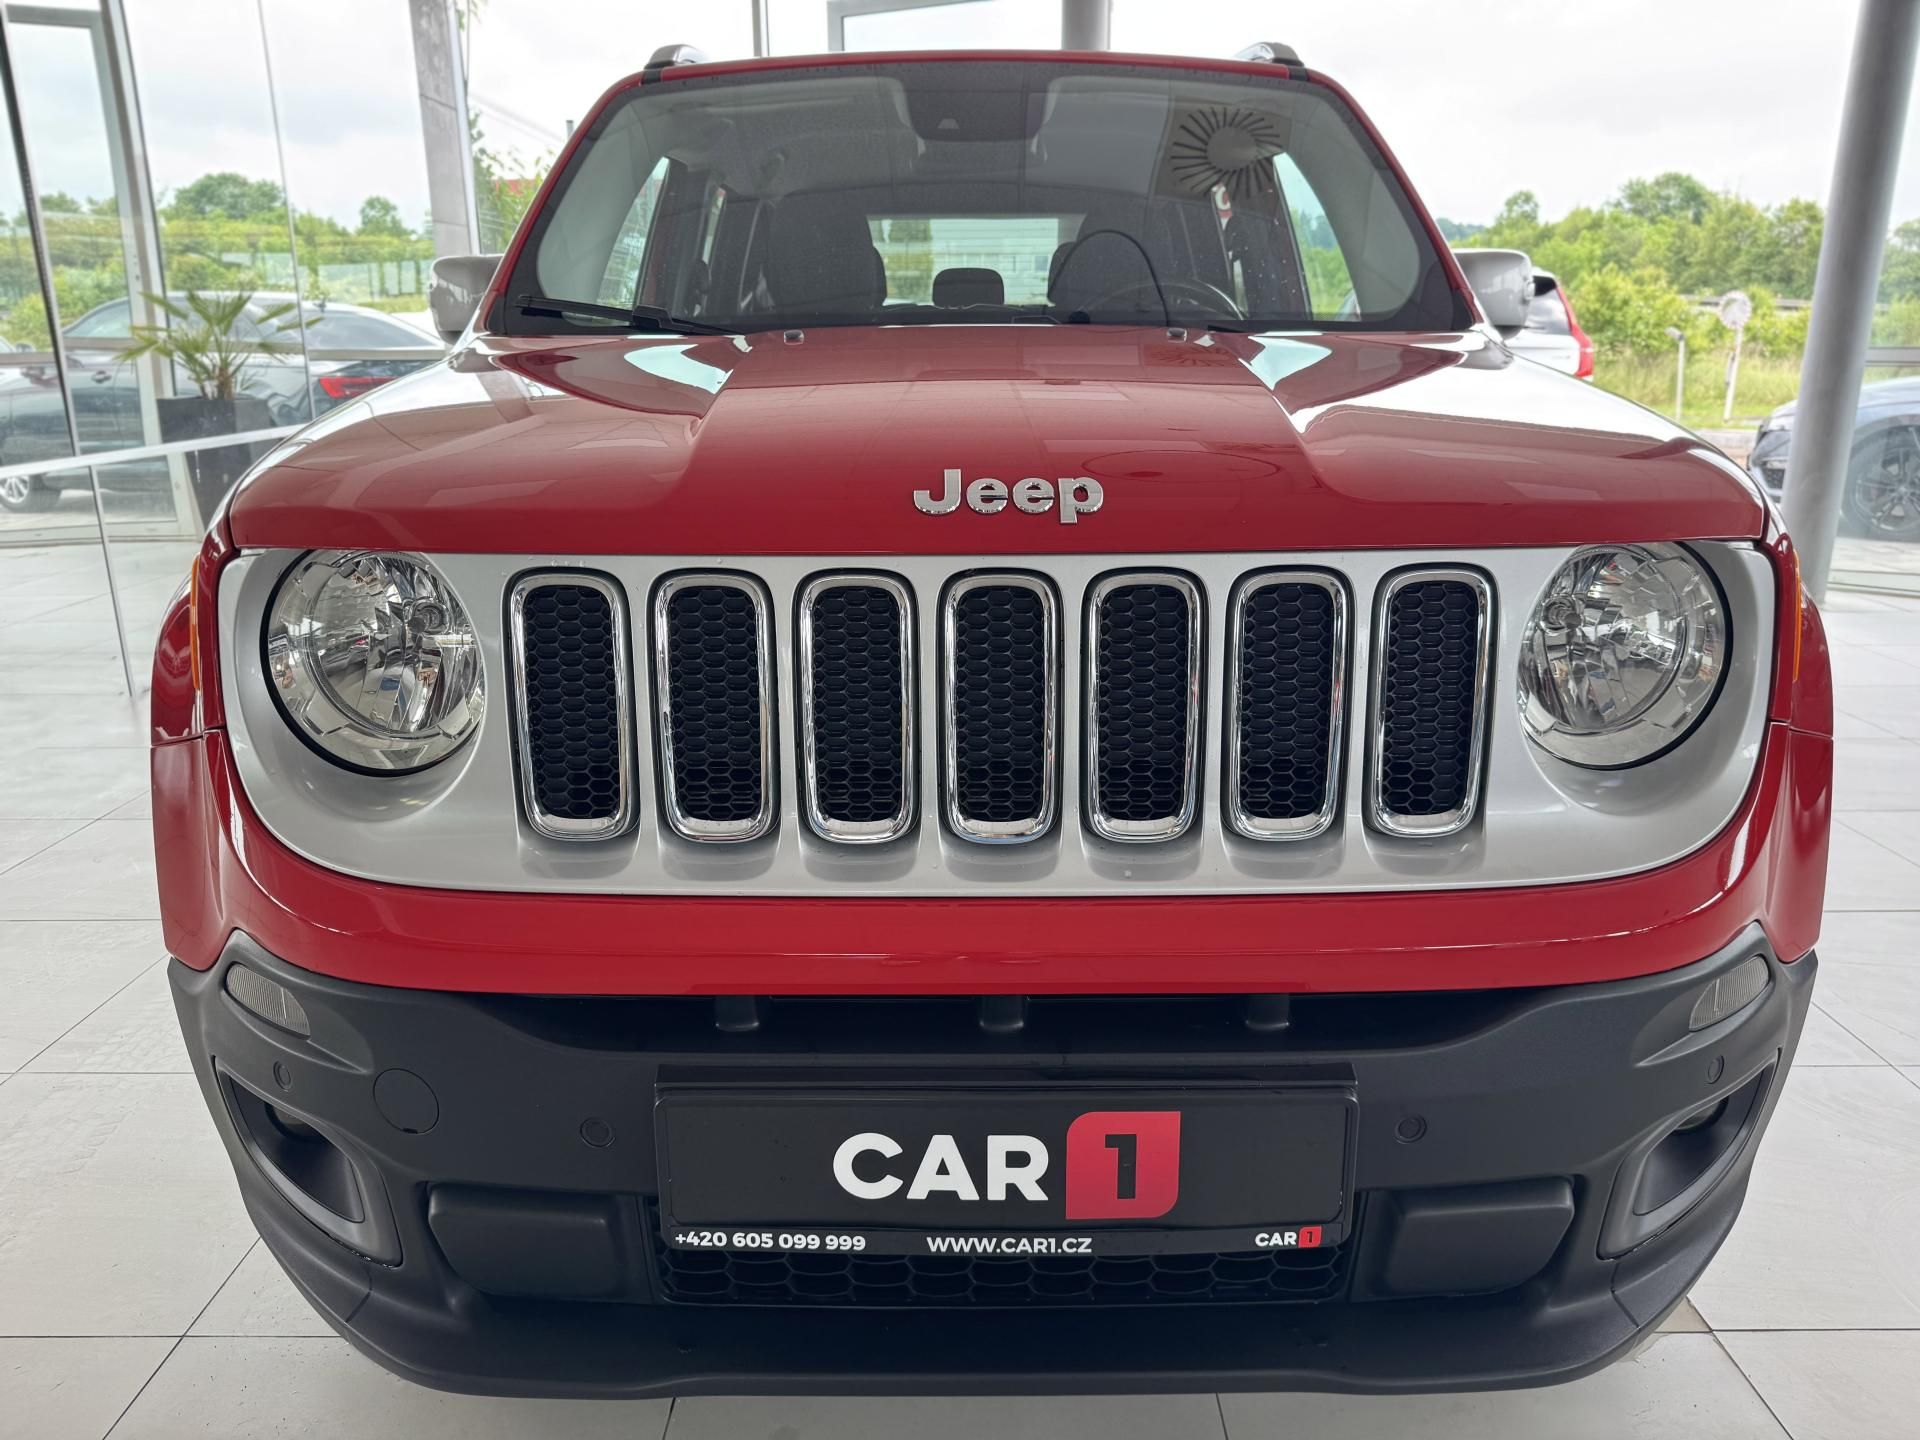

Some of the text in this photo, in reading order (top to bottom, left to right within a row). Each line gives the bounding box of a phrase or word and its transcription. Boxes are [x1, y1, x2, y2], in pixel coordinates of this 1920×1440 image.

[913, 468, 1104, 524] Jeep
[832, 1132, 1137, 1201] CAR 1
[675, 1231, 867, 1251] +420 605 099 999
[926, 1236, 1093, 1254] WWW.CAR1.CZ
